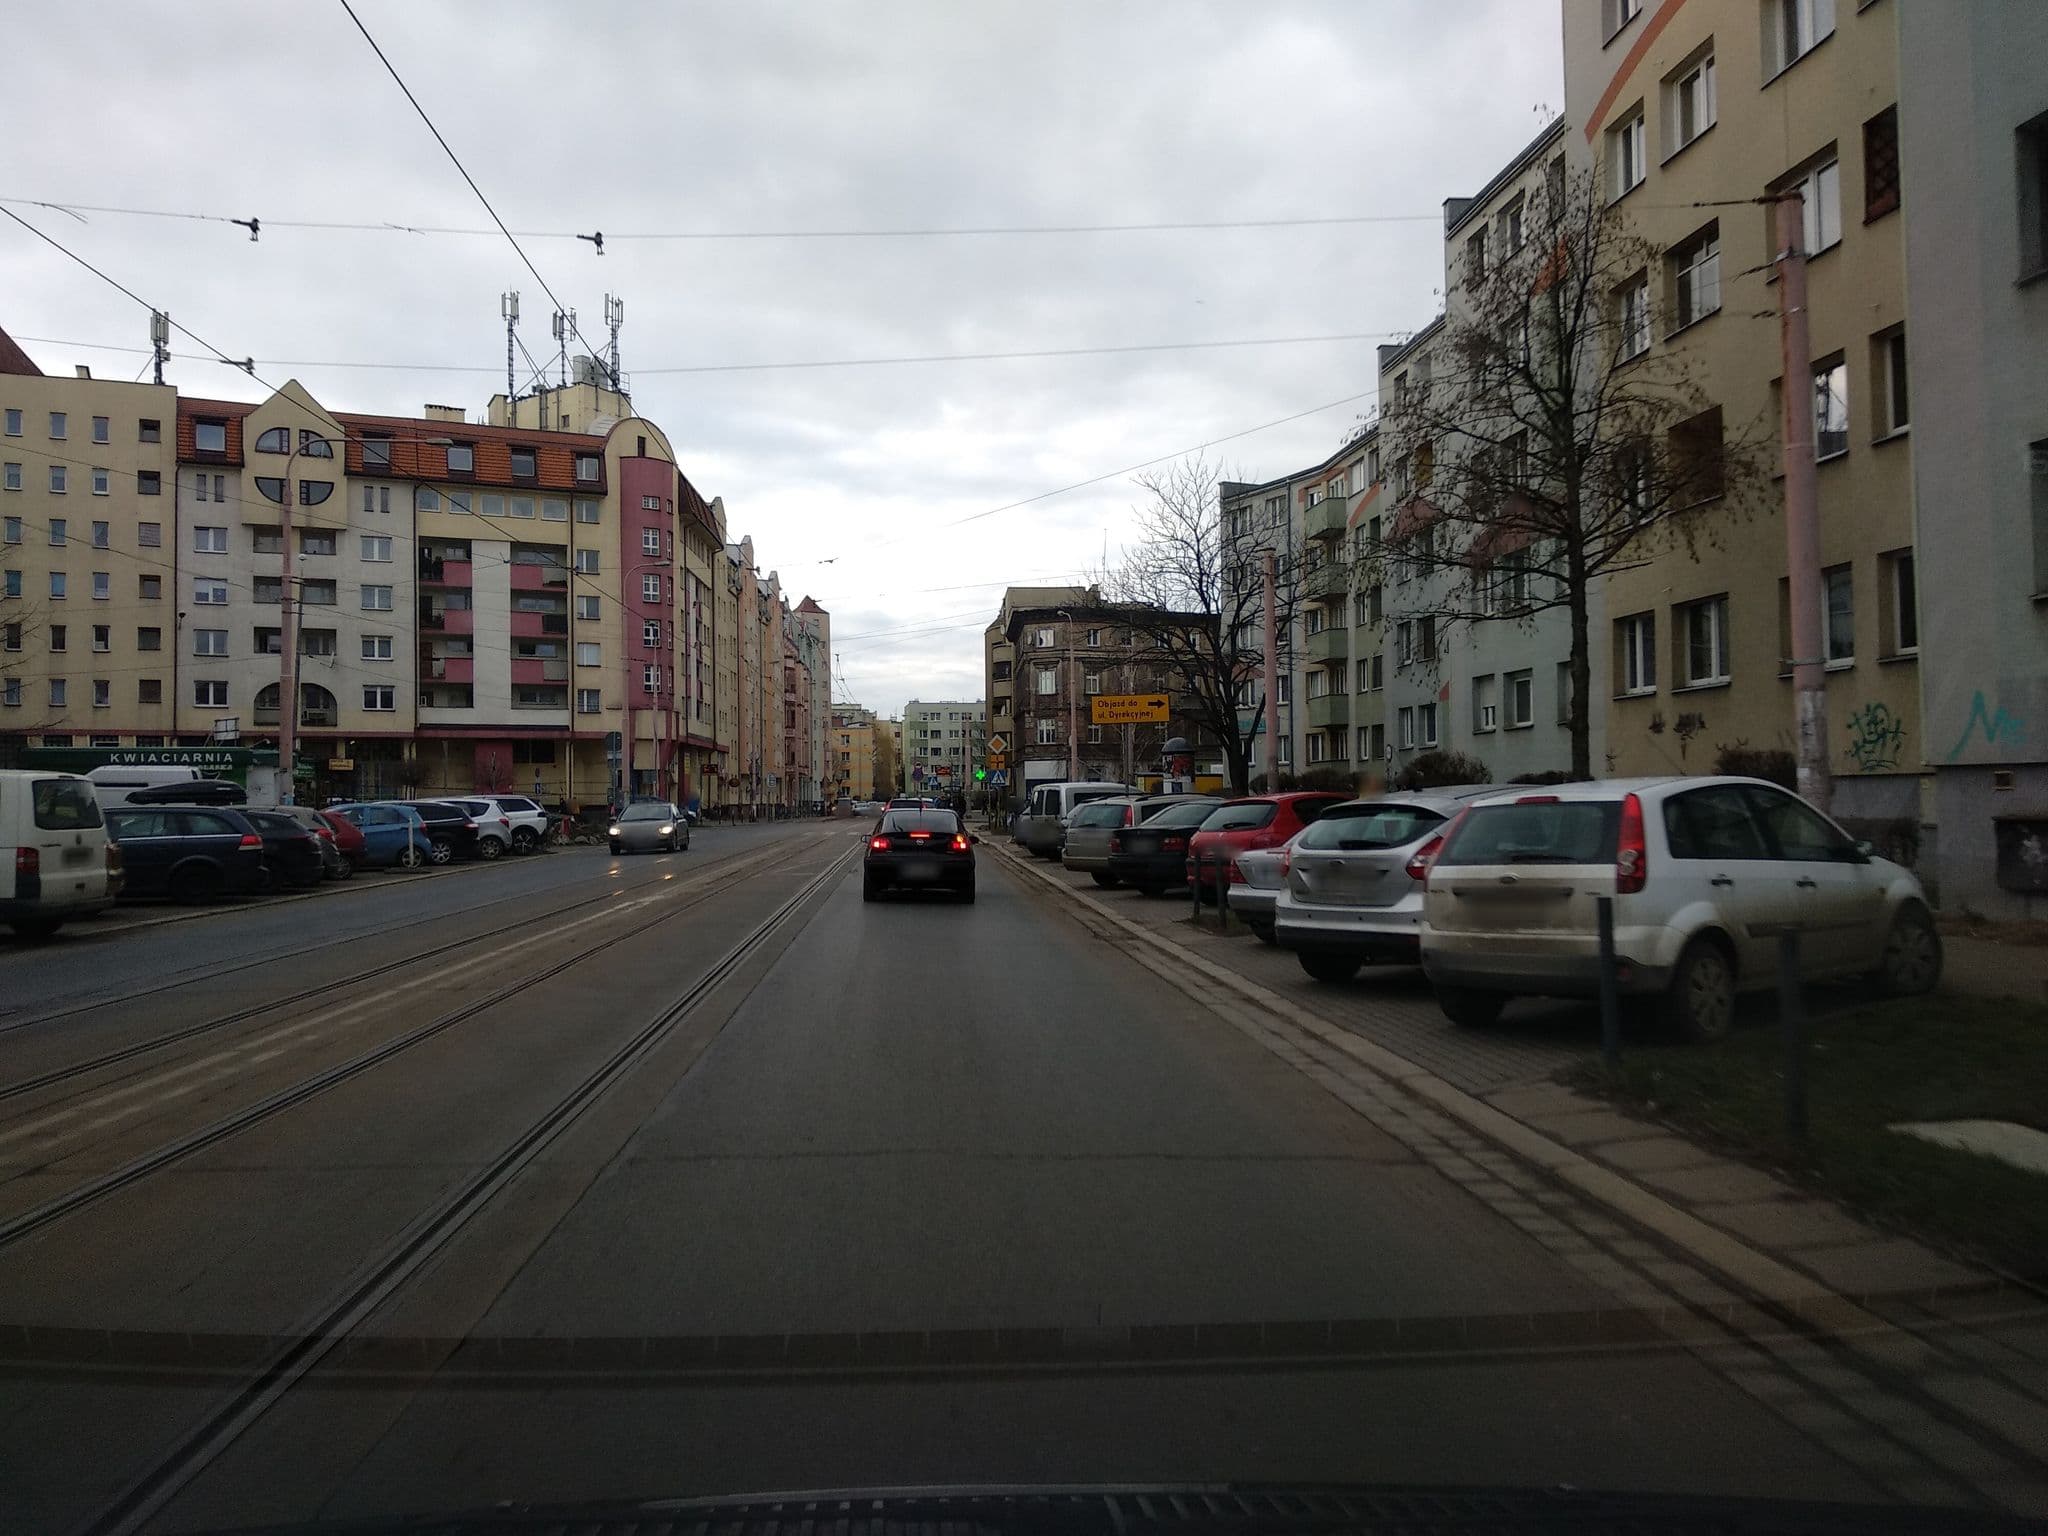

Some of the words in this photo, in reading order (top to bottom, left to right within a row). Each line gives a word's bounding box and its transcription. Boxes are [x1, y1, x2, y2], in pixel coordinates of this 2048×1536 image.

[1098, 700, 1125, 709] Objazd
[1128, 699, 1138, 707] do
[110, 753, 233, 763] KWIACIARNIA
